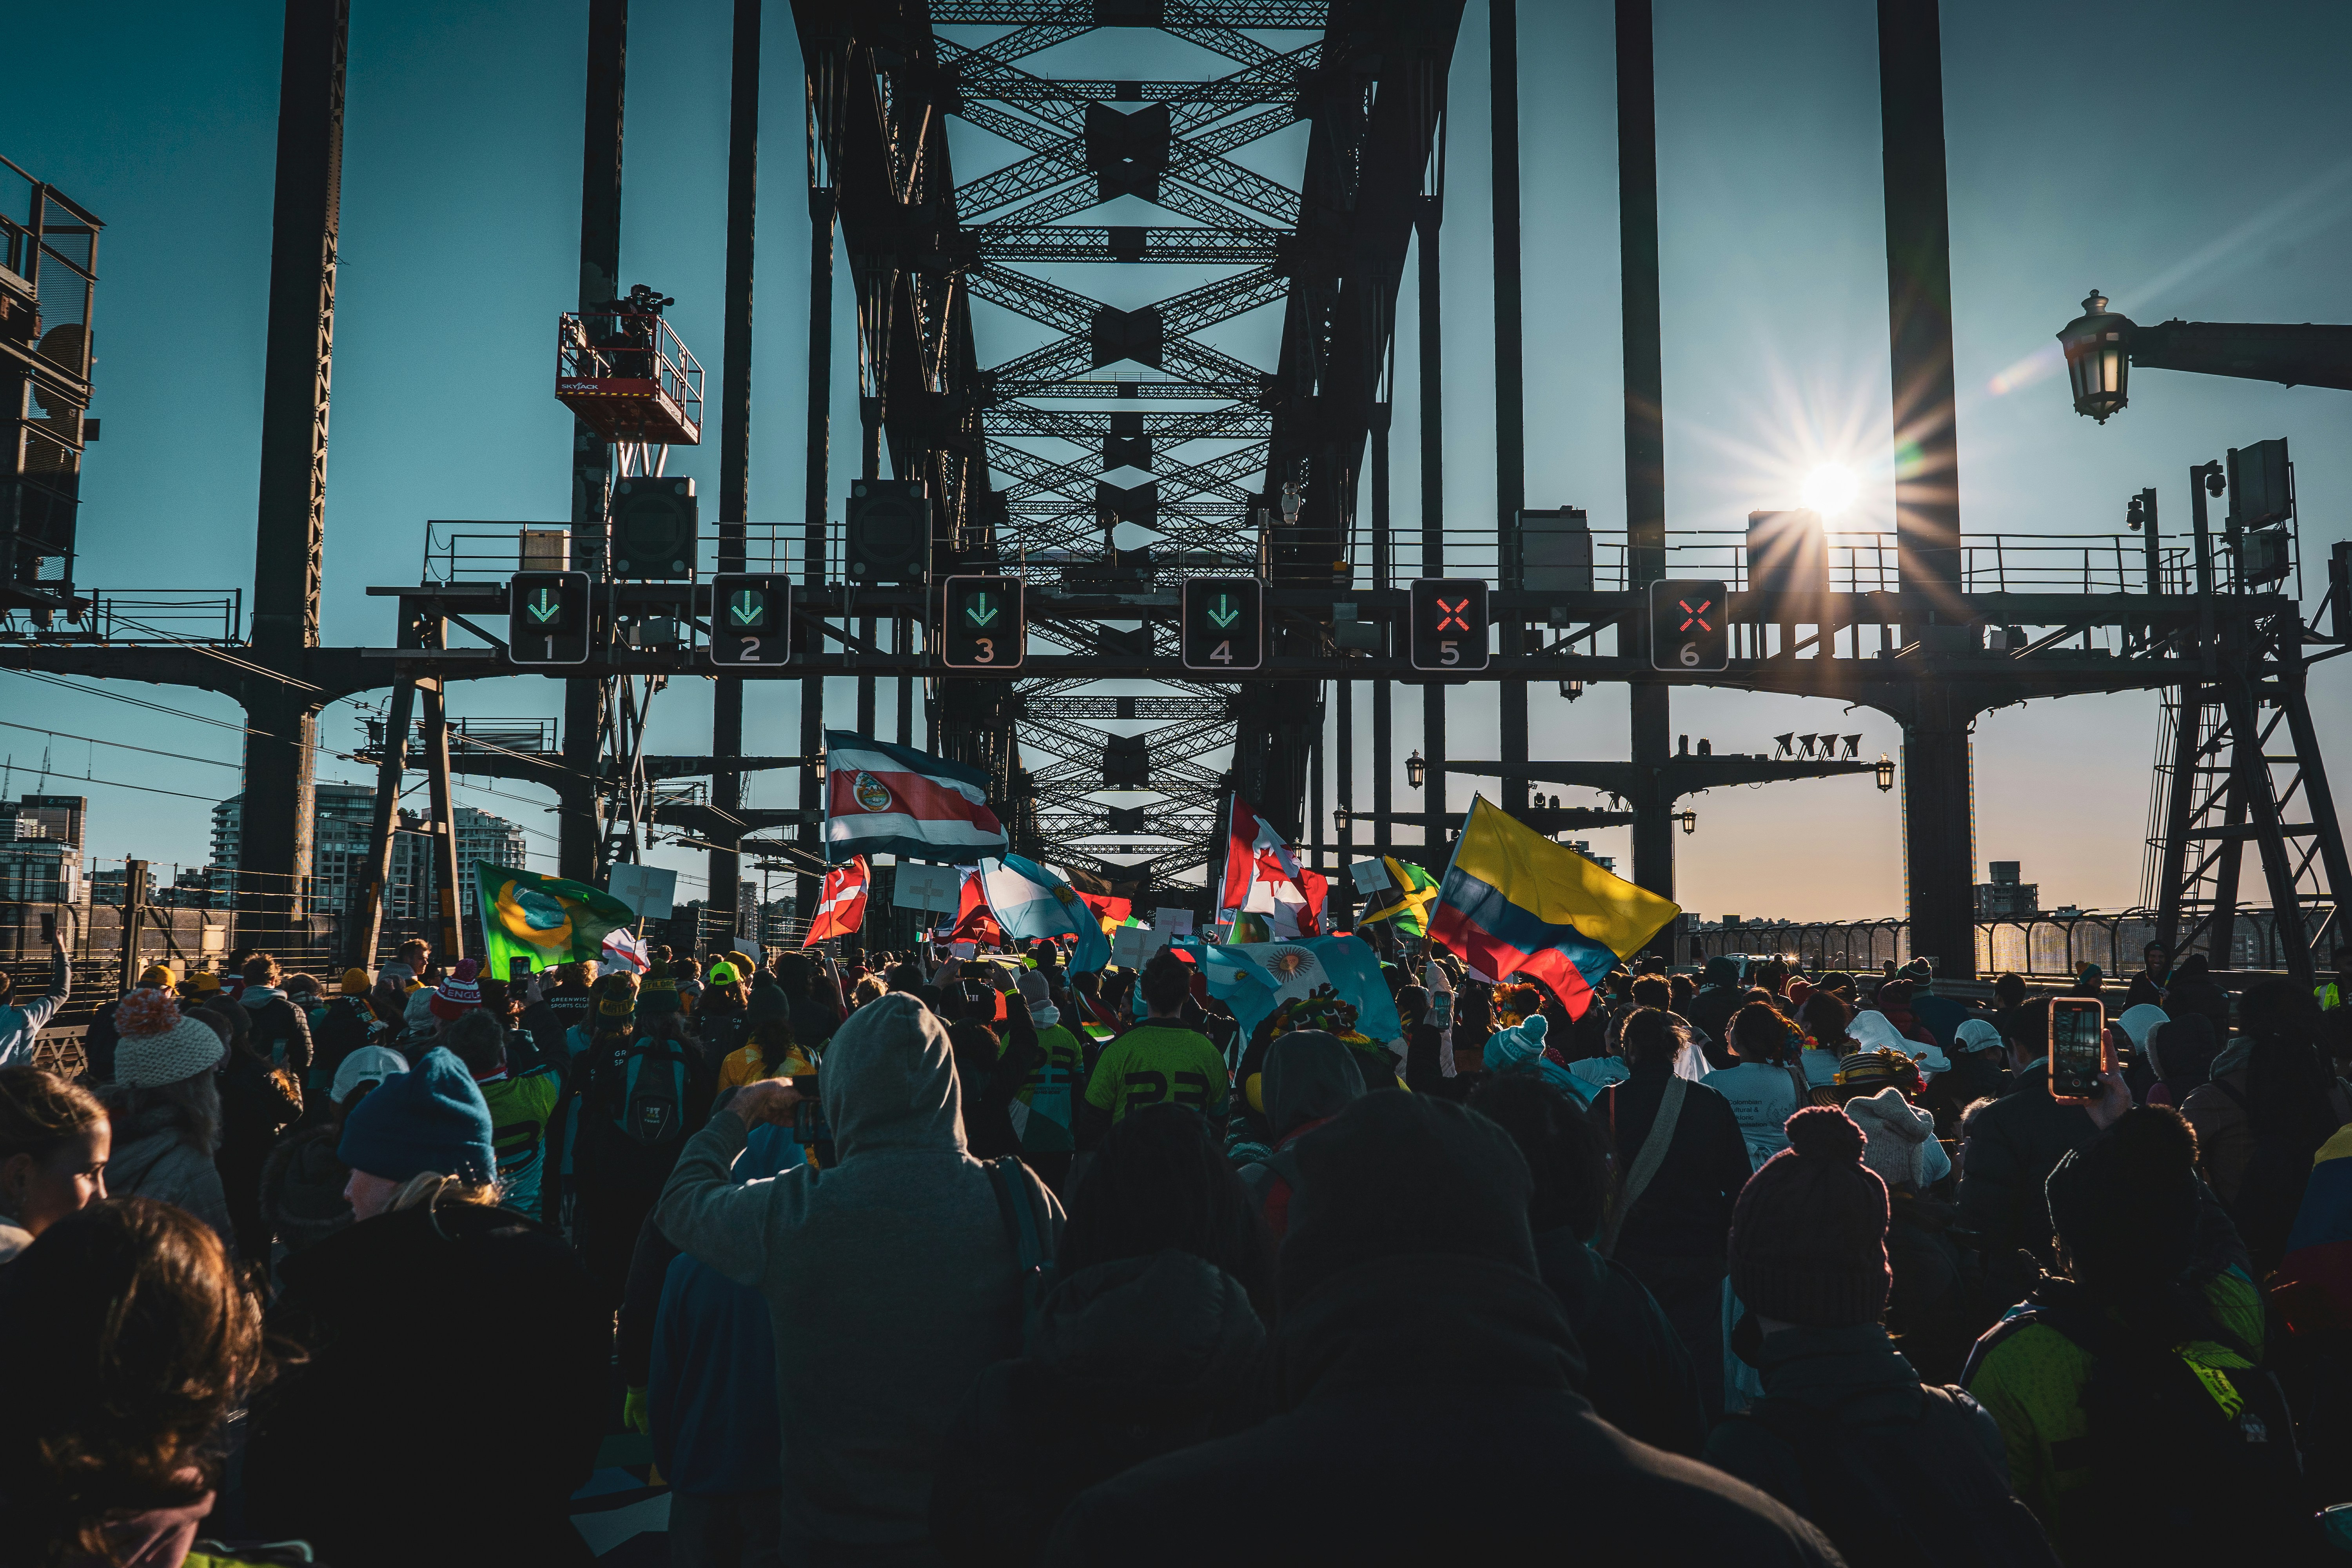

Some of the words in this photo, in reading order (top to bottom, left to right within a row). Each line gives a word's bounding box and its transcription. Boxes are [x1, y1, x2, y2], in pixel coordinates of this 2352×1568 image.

[545, 635, 552, 659] 1
[740, 637, 760, 661] 2
[975, 639, 994, 663] 3
[1210, 641, 1232, 664] 4
[1441, 641, 1459, 665] 5
[1681, 642, 1699, 666] 6
[447, 989, 481, 998] ENGLA
